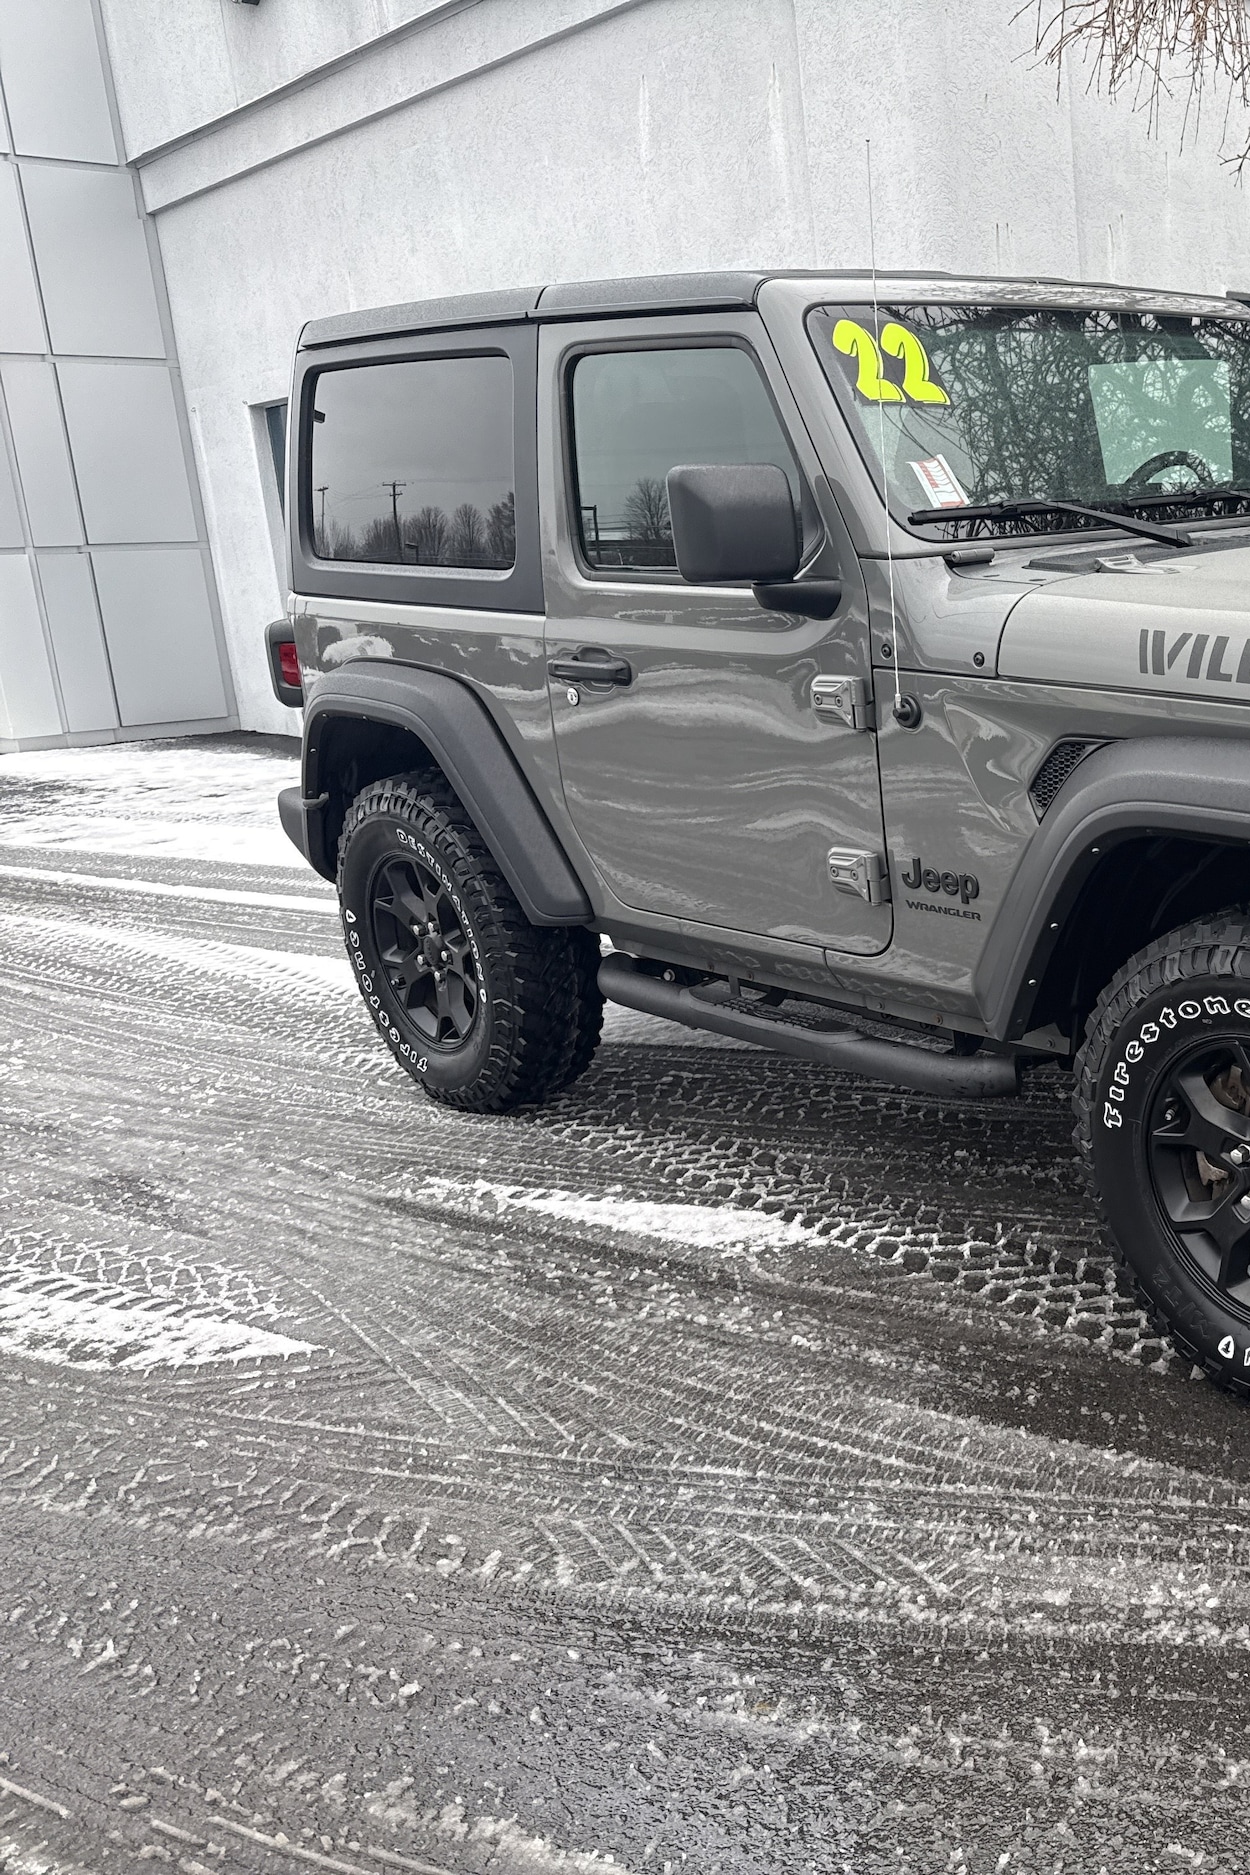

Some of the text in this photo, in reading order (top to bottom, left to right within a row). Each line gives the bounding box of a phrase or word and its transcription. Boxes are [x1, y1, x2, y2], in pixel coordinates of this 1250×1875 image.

[832, 319, 951, 405] 22
[396, 828, 484, 981] DESTINATION
[901, 856, 979, 905] Jeep
[905, 899, 982, 921] WRANGLER
